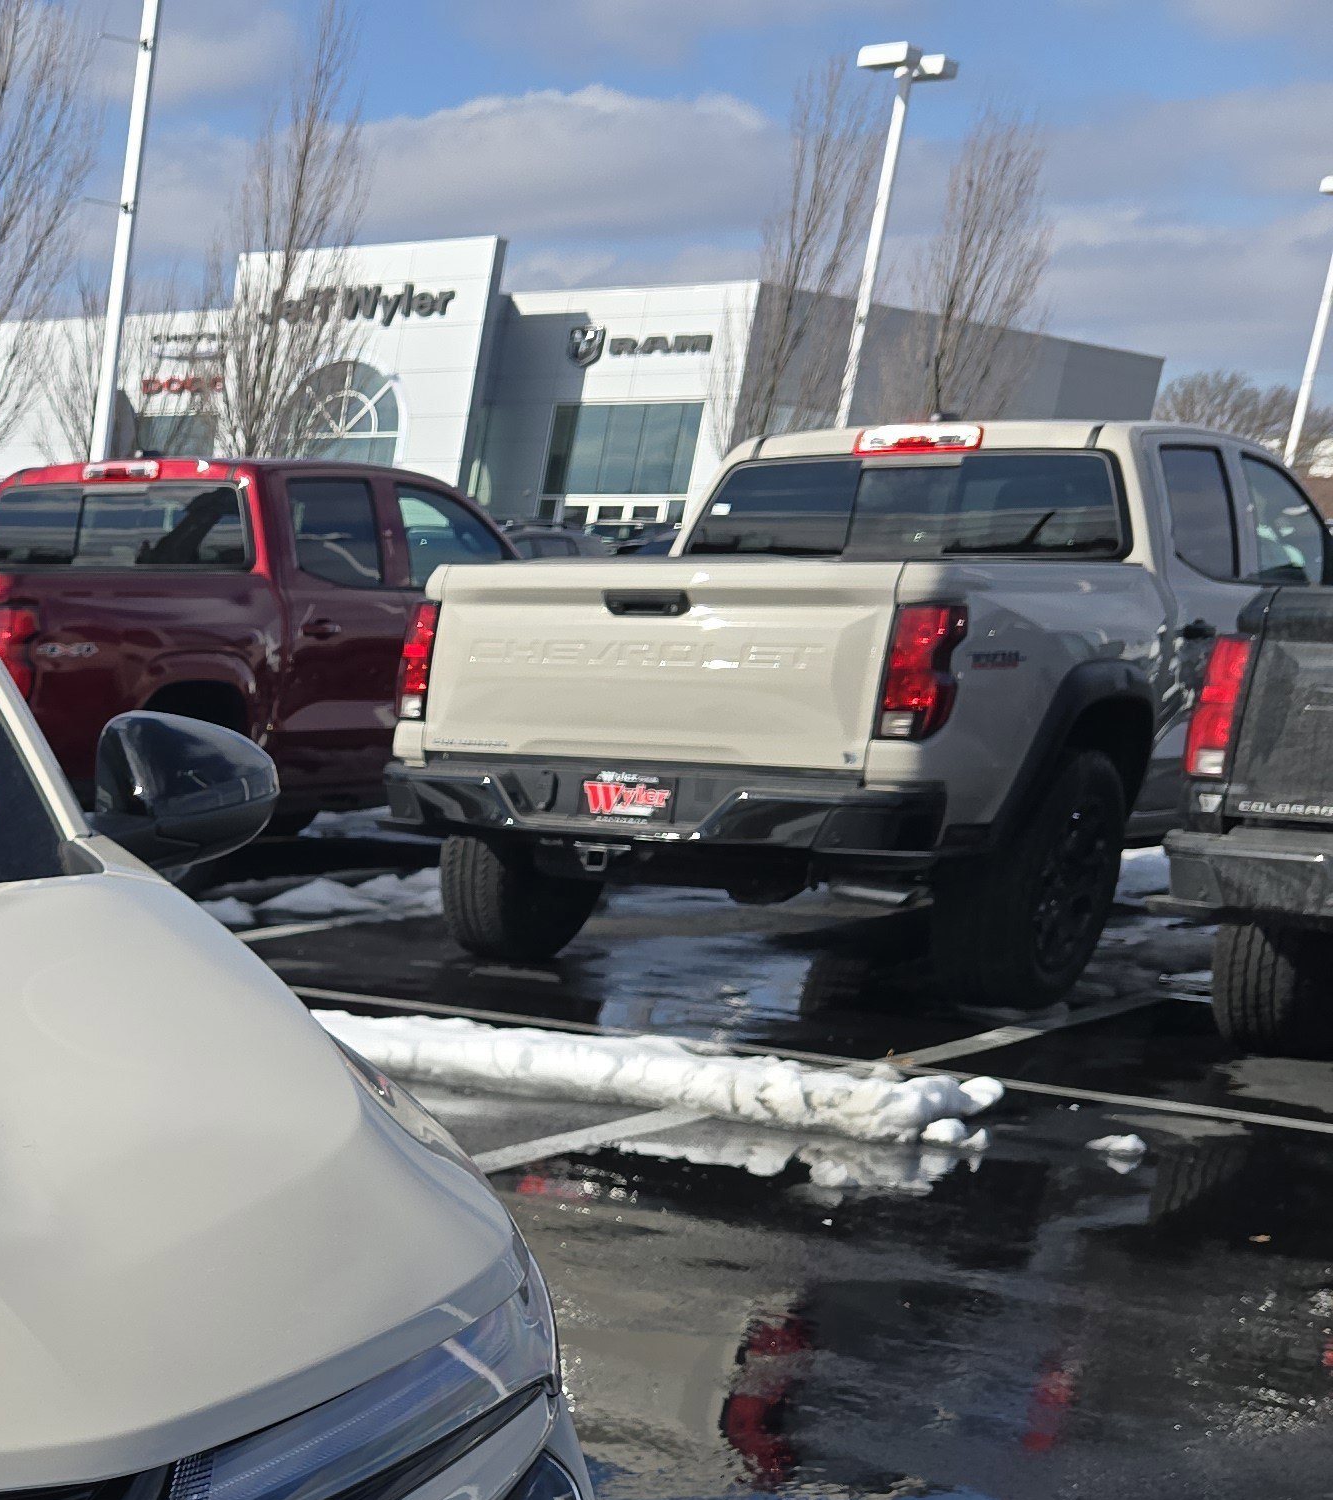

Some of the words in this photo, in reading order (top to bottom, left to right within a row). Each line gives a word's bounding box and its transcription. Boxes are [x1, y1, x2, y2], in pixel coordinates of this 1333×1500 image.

[342, 282, 456, 327] Wyler
[609, 334, 714, 356] RAM
[467, 638, 829, 671] CHEVROLET
[583, 780, 672, 815] Wyler
